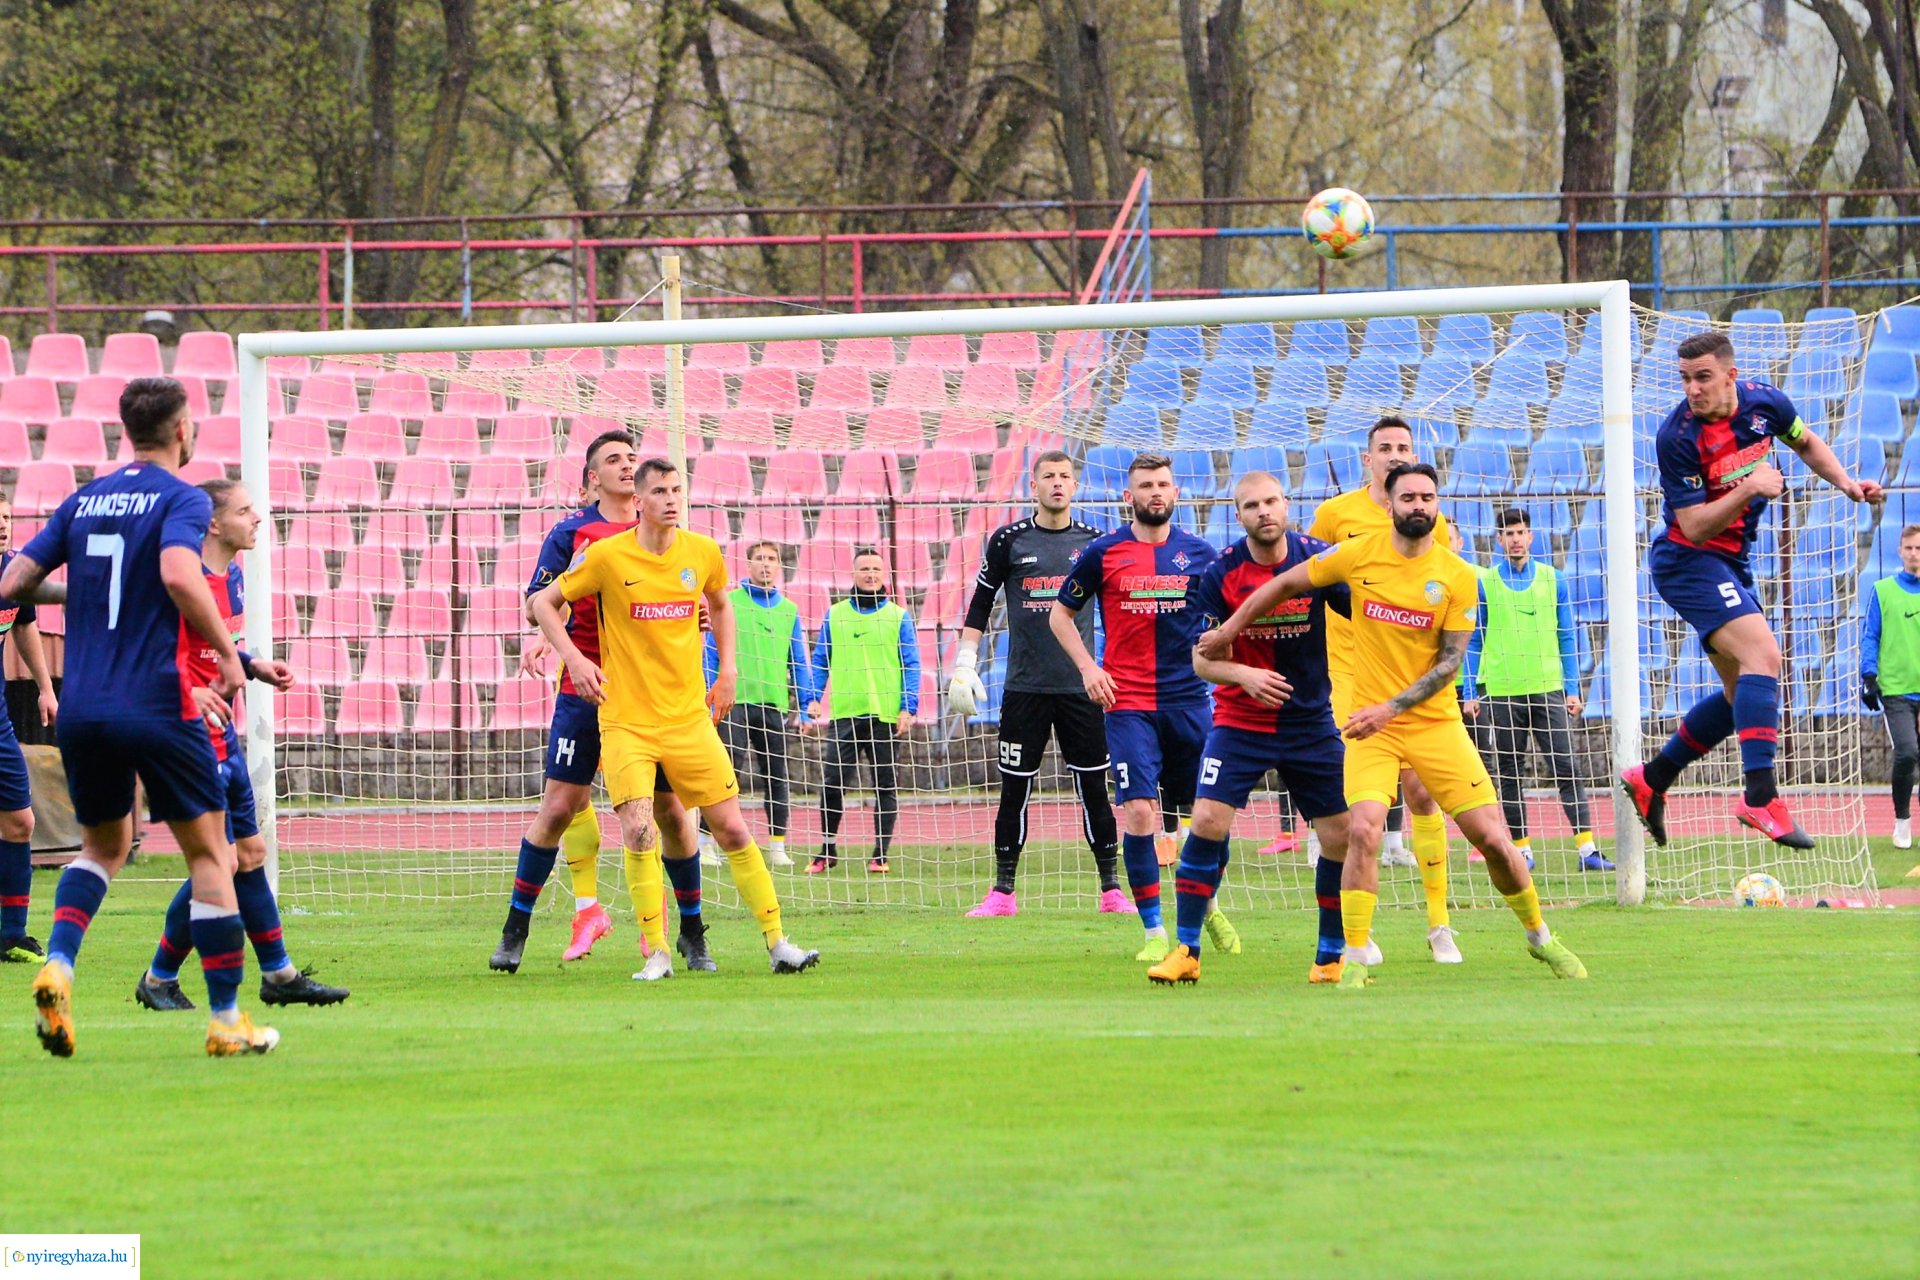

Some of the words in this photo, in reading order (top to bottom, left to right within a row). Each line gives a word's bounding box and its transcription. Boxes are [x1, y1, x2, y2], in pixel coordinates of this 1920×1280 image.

[74, 492, 161, 519] ZAMOSTNY
[86, 533, 125, 630] 7
[1021, 575, 1068, 590] REVE
[1119, 575, 1190, 591] REVESZ
[1717, 581, 1742, 608] 5
[555, 737, 576, 767] 14
[1000, 741, 1022, 767] 95
[1116, 762, 1130, 789] 3
[1200, 757, 1222, 785] 15
